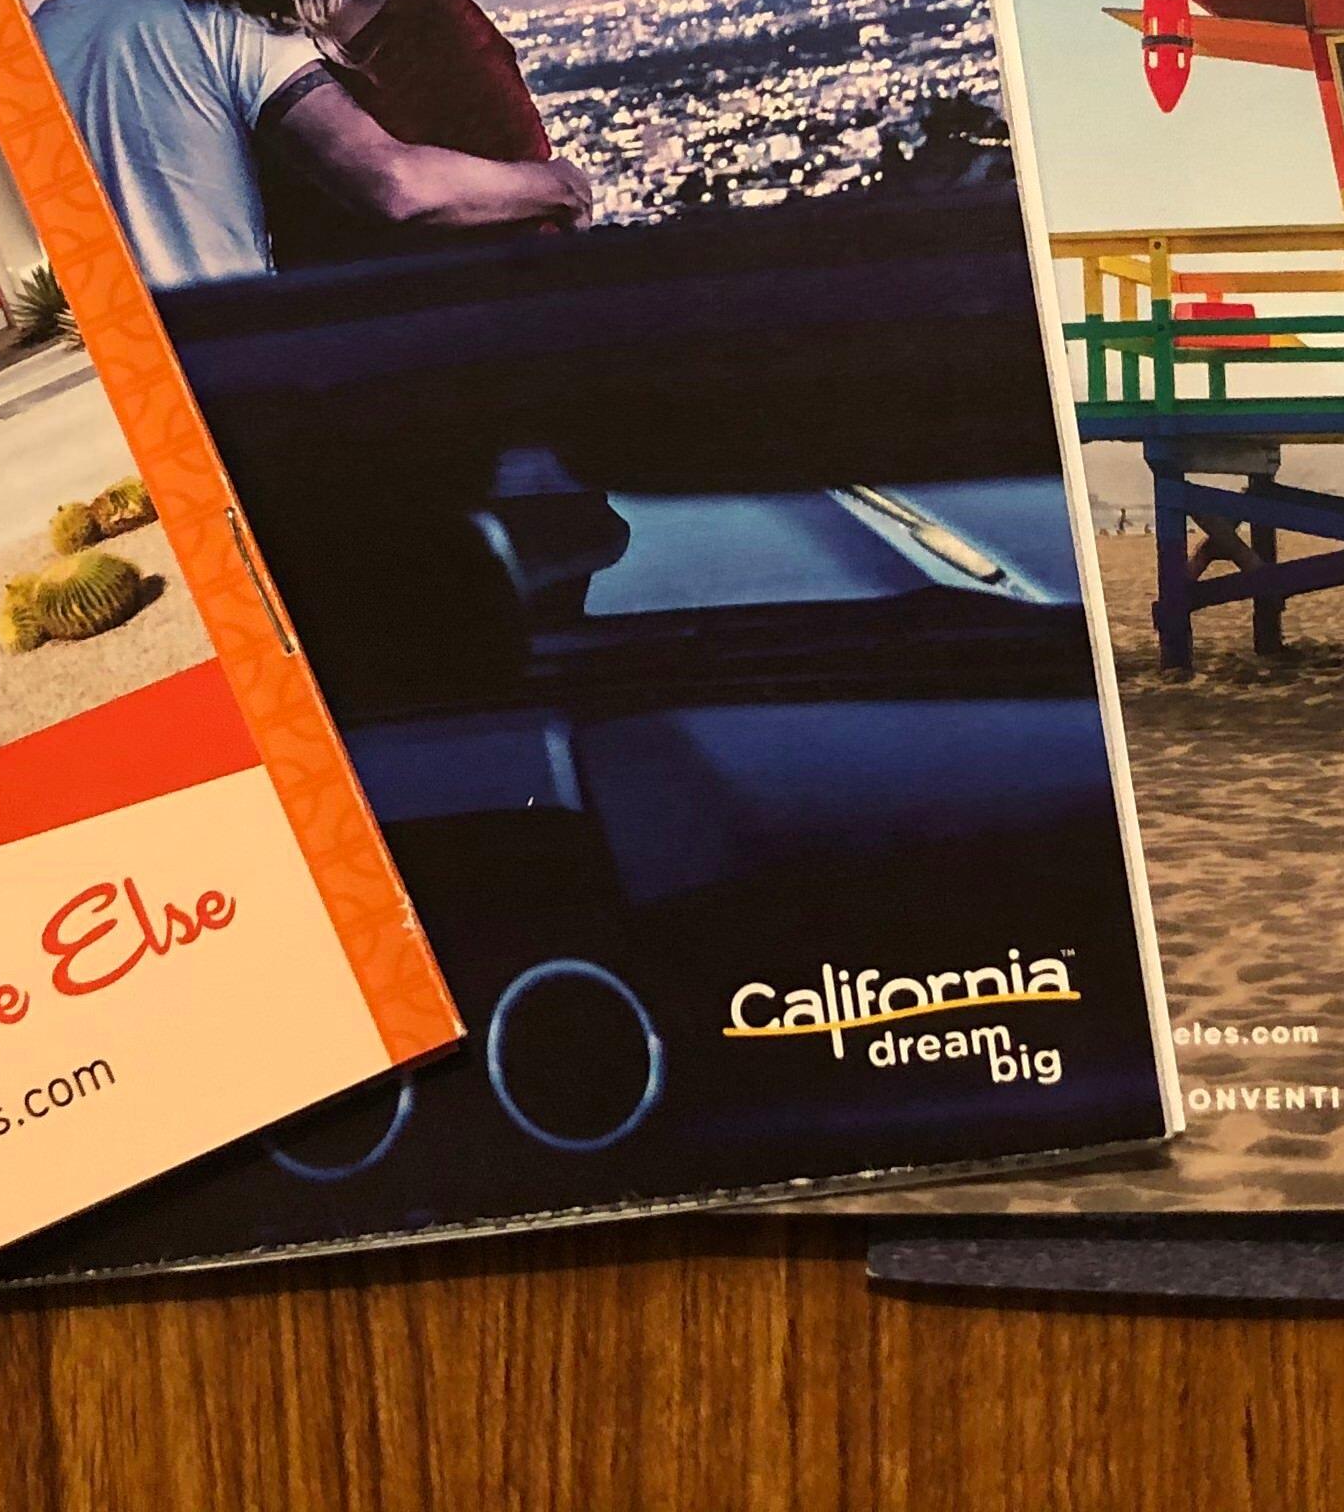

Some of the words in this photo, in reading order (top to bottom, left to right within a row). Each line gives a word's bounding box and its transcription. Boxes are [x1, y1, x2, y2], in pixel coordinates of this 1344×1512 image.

[40, 876, 237, 997] Else
[729, 948, 1071, 1058] California
[868, 1021, 1011, 1067] dream
[1172, 1022, 1319, 1046] eles.com
[989, 1040, 1062, 1084] big
